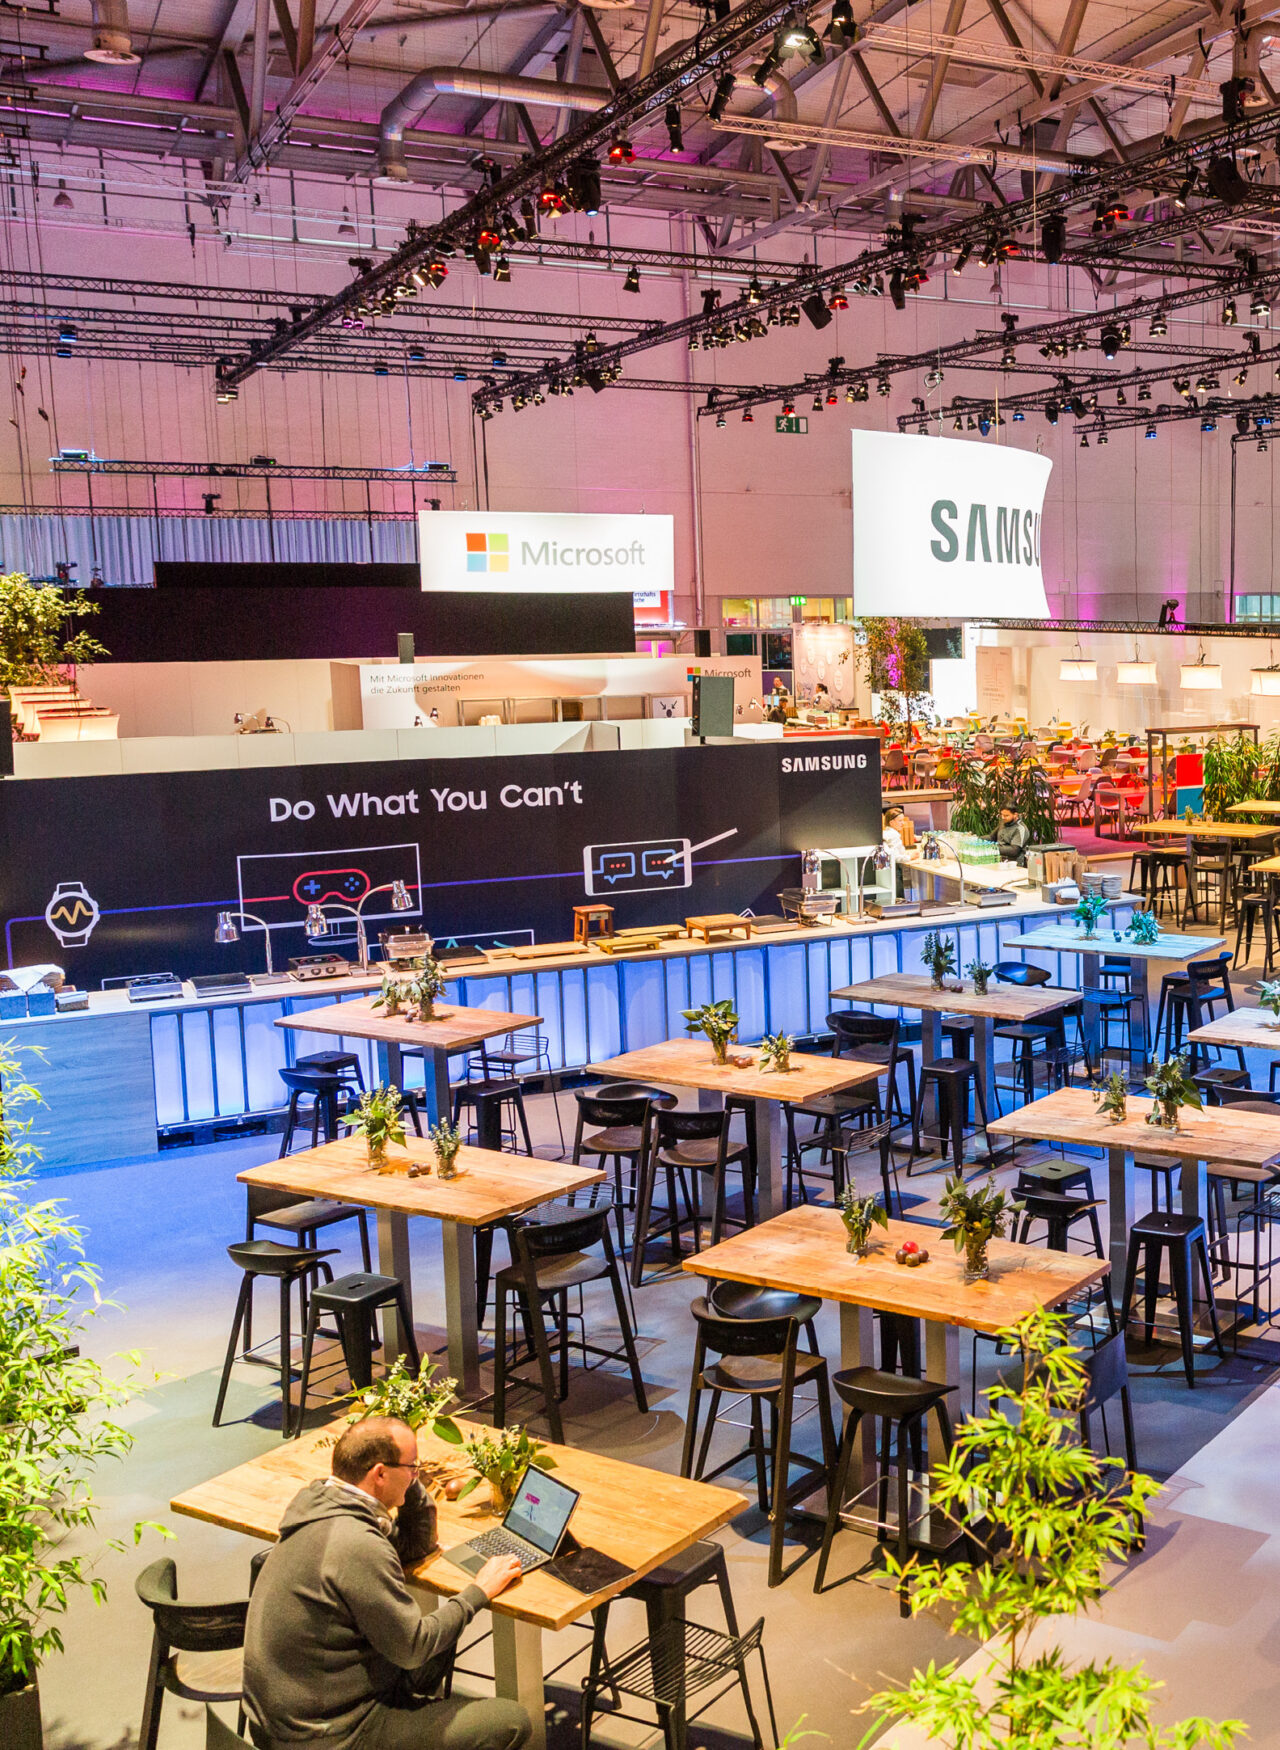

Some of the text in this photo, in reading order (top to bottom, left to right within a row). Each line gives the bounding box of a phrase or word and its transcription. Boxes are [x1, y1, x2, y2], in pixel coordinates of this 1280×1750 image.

[520, 540, 645, 566] Microsoft
[370, 673, 484, 683] Mit Microsoft Innovationen
[370, 684, 461, 694] die Zukunft gestalten
[781, 754, 867, 773] SAMSUNG
[269, 780, 583, 822] Do What You Can't
